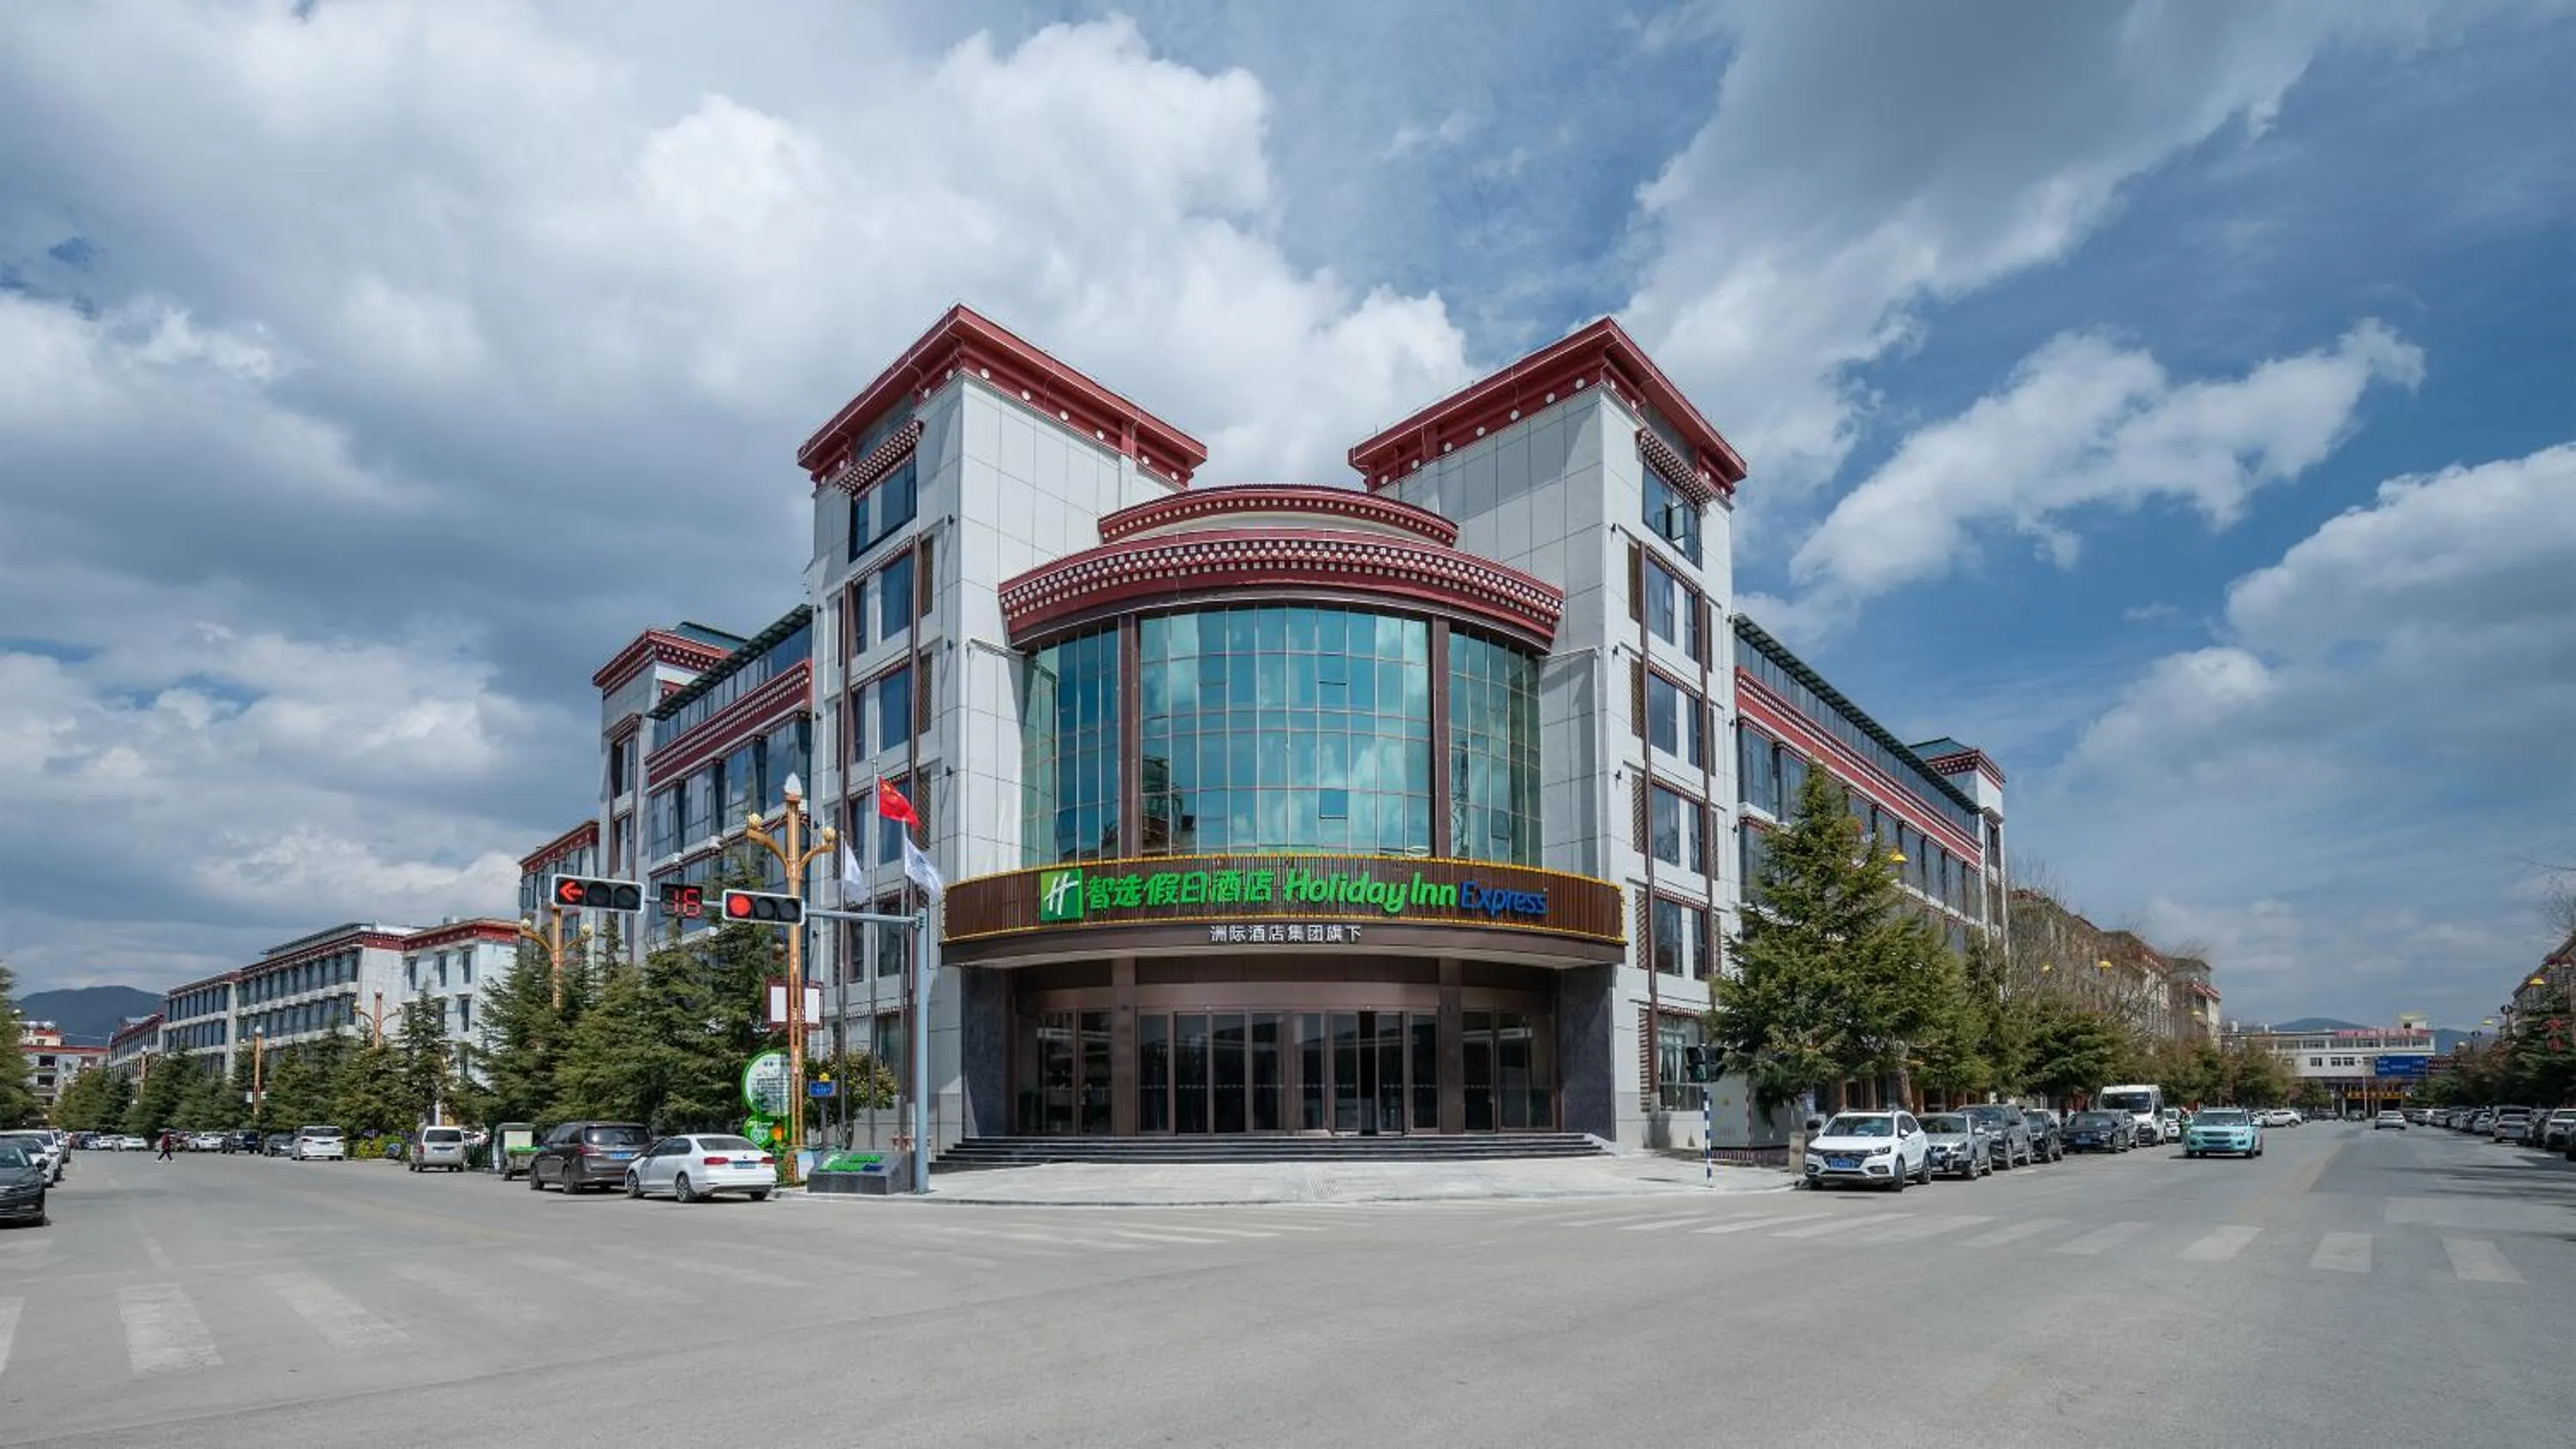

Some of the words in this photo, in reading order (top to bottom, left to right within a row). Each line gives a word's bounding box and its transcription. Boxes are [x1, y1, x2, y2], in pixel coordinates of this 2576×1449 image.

[1086, 869, 1275, 910] 智选假日酒店
[1284, 868, 1407, 913] Holiday
[1411, 871, 1456, 906] Inn
[1460, 880, 1546, 917] Express
[1209, 924, 1362, 943] 洲际酒店集团旗下
